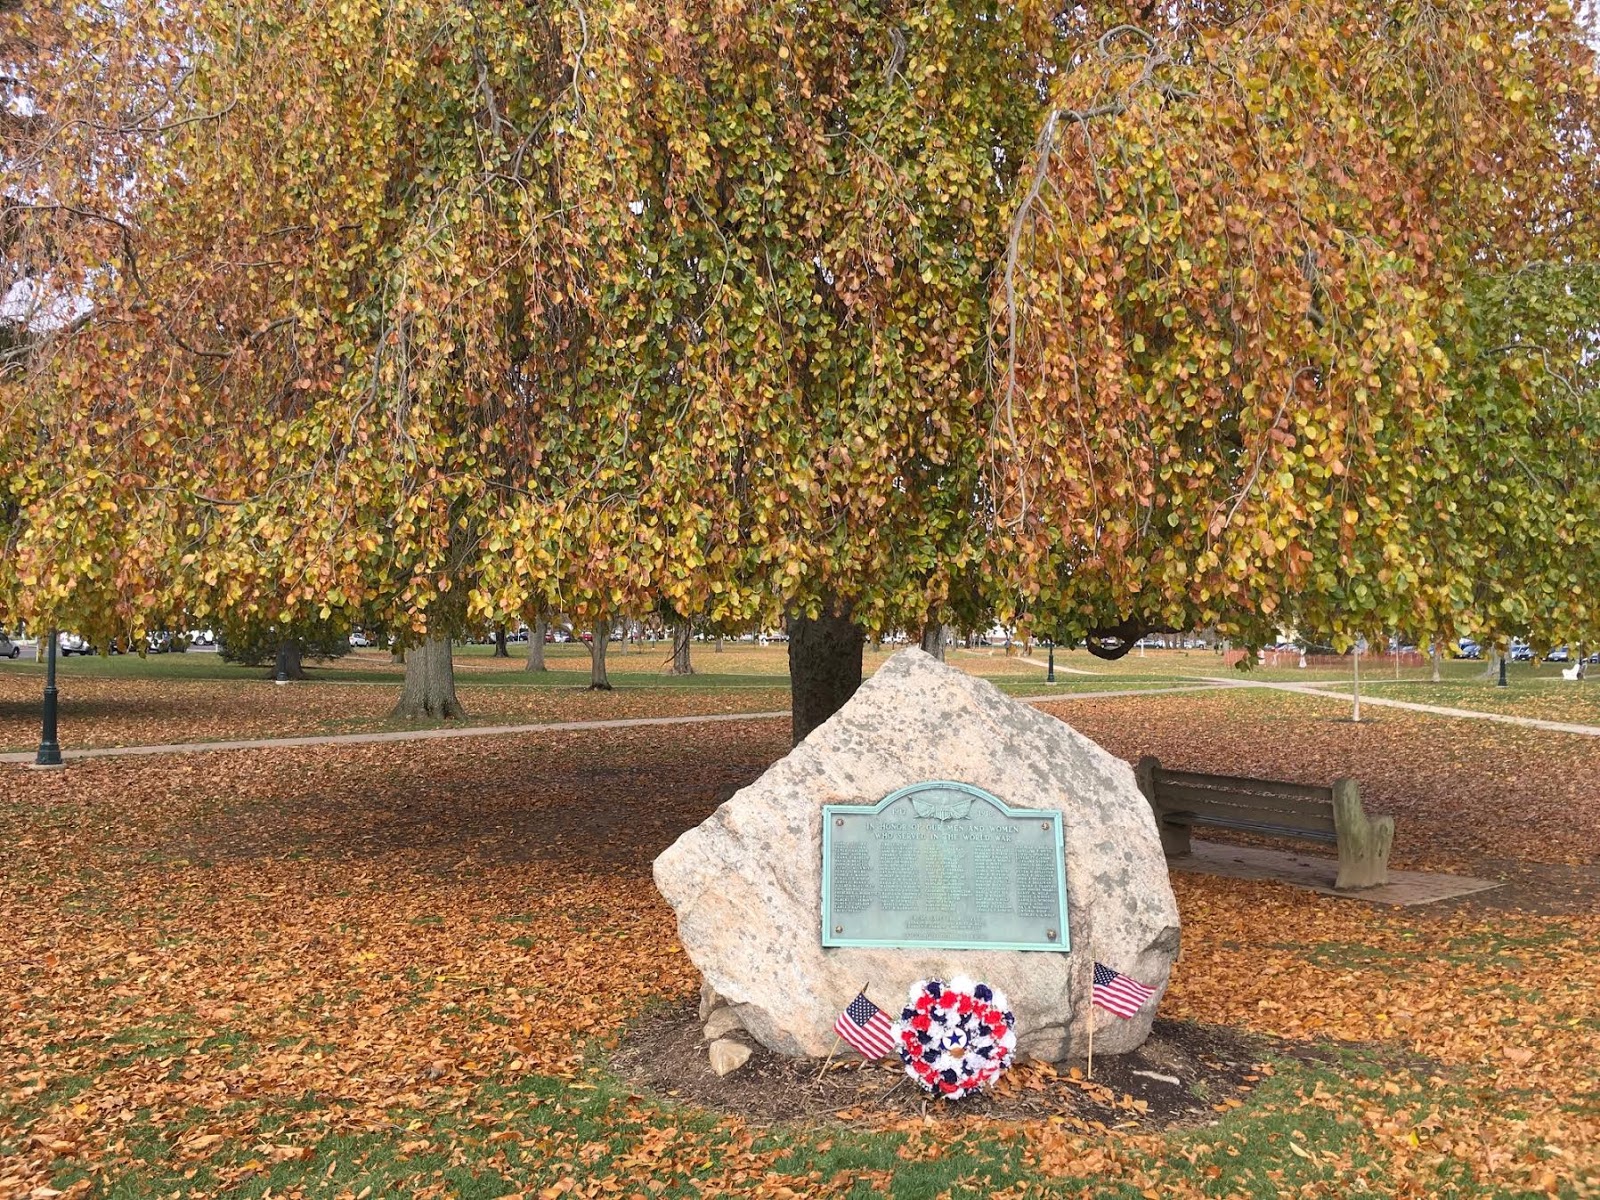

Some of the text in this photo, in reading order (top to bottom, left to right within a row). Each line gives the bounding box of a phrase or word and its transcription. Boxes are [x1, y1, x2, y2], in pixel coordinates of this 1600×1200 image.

[866, 822, 1019, 834] IN HONOR OF OUR MEN AND WOMEN
[874, 832, 1012, 843] WHO SERVED IN THE WORLD WAR
